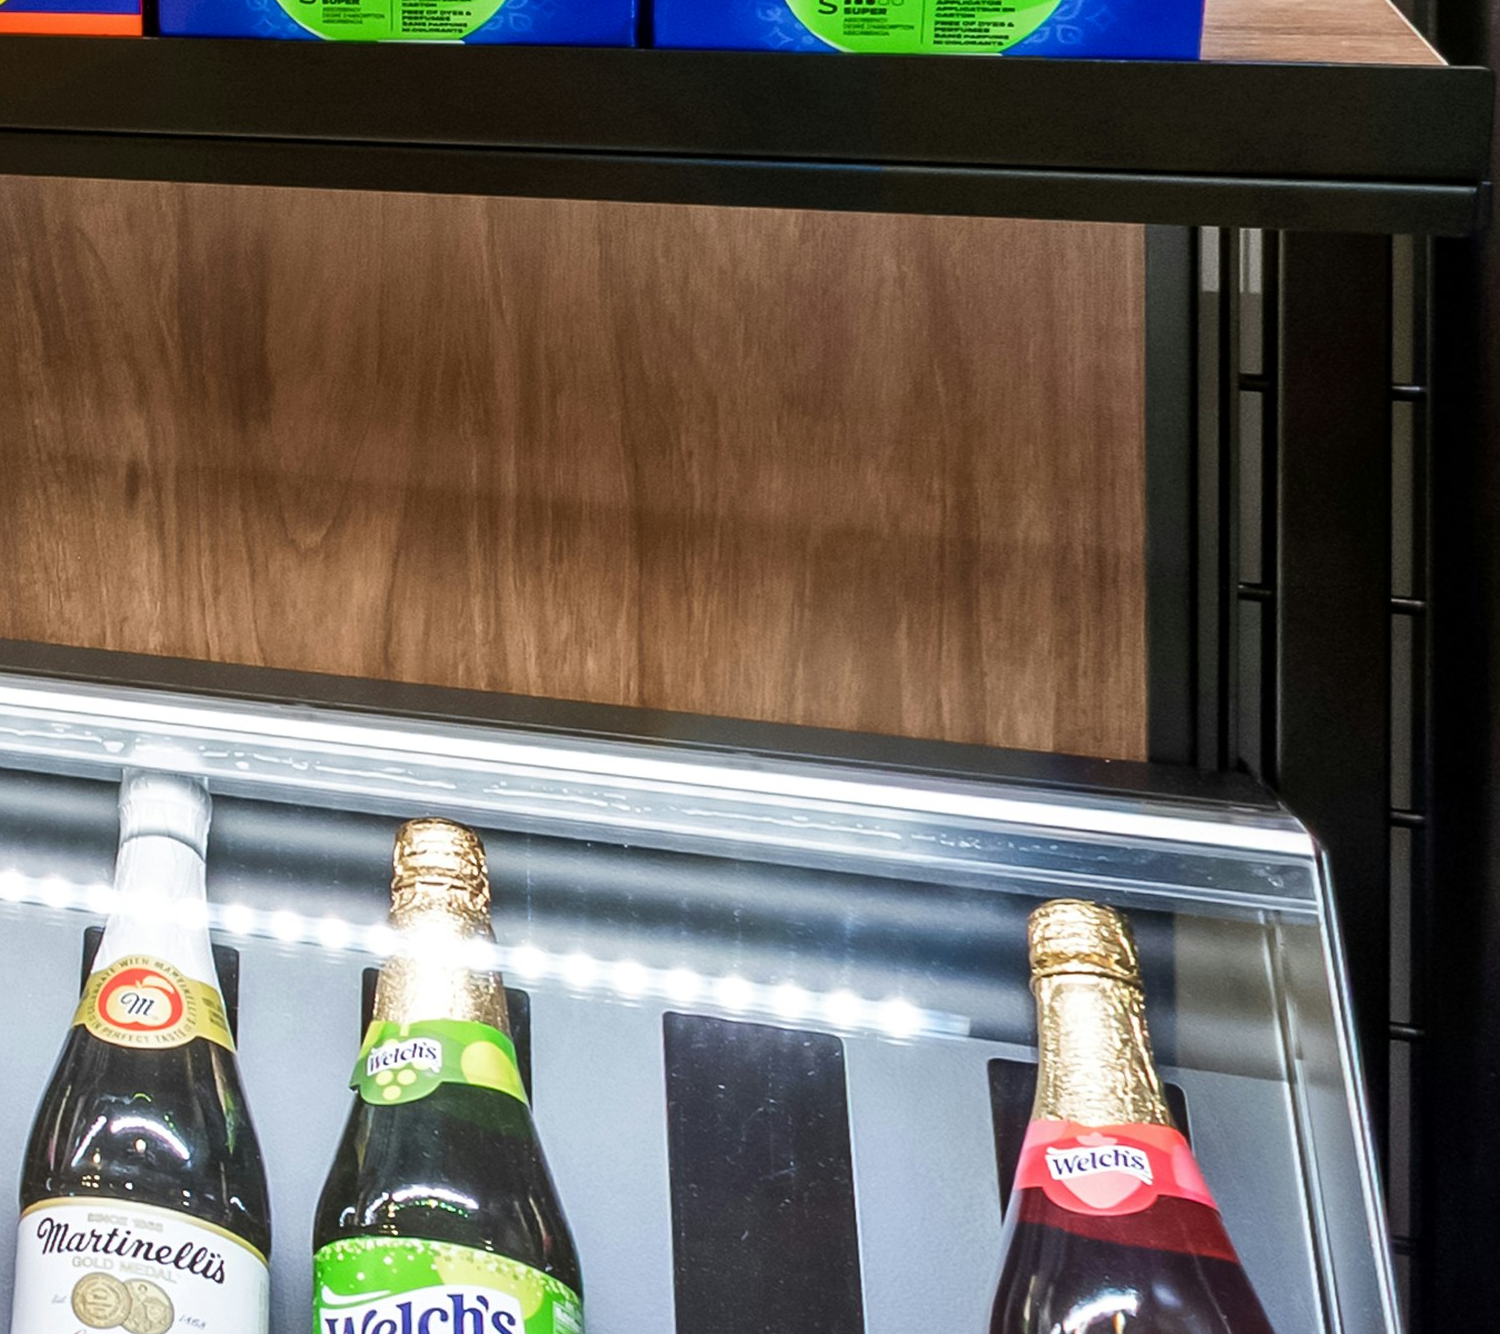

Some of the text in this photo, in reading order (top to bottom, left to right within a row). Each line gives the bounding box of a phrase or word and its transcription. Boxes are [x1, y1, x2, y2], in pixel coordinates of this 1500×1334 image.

[843, 7, 887, 15] SUPER
[368, 1039, 438, 1073] Welch's
[1052, 1149, 1147, 1178] Welch's
[36, 1216, 227, 1285] Martinelli's
[71, 1255, 175, 1283] GOLD MEDAL
